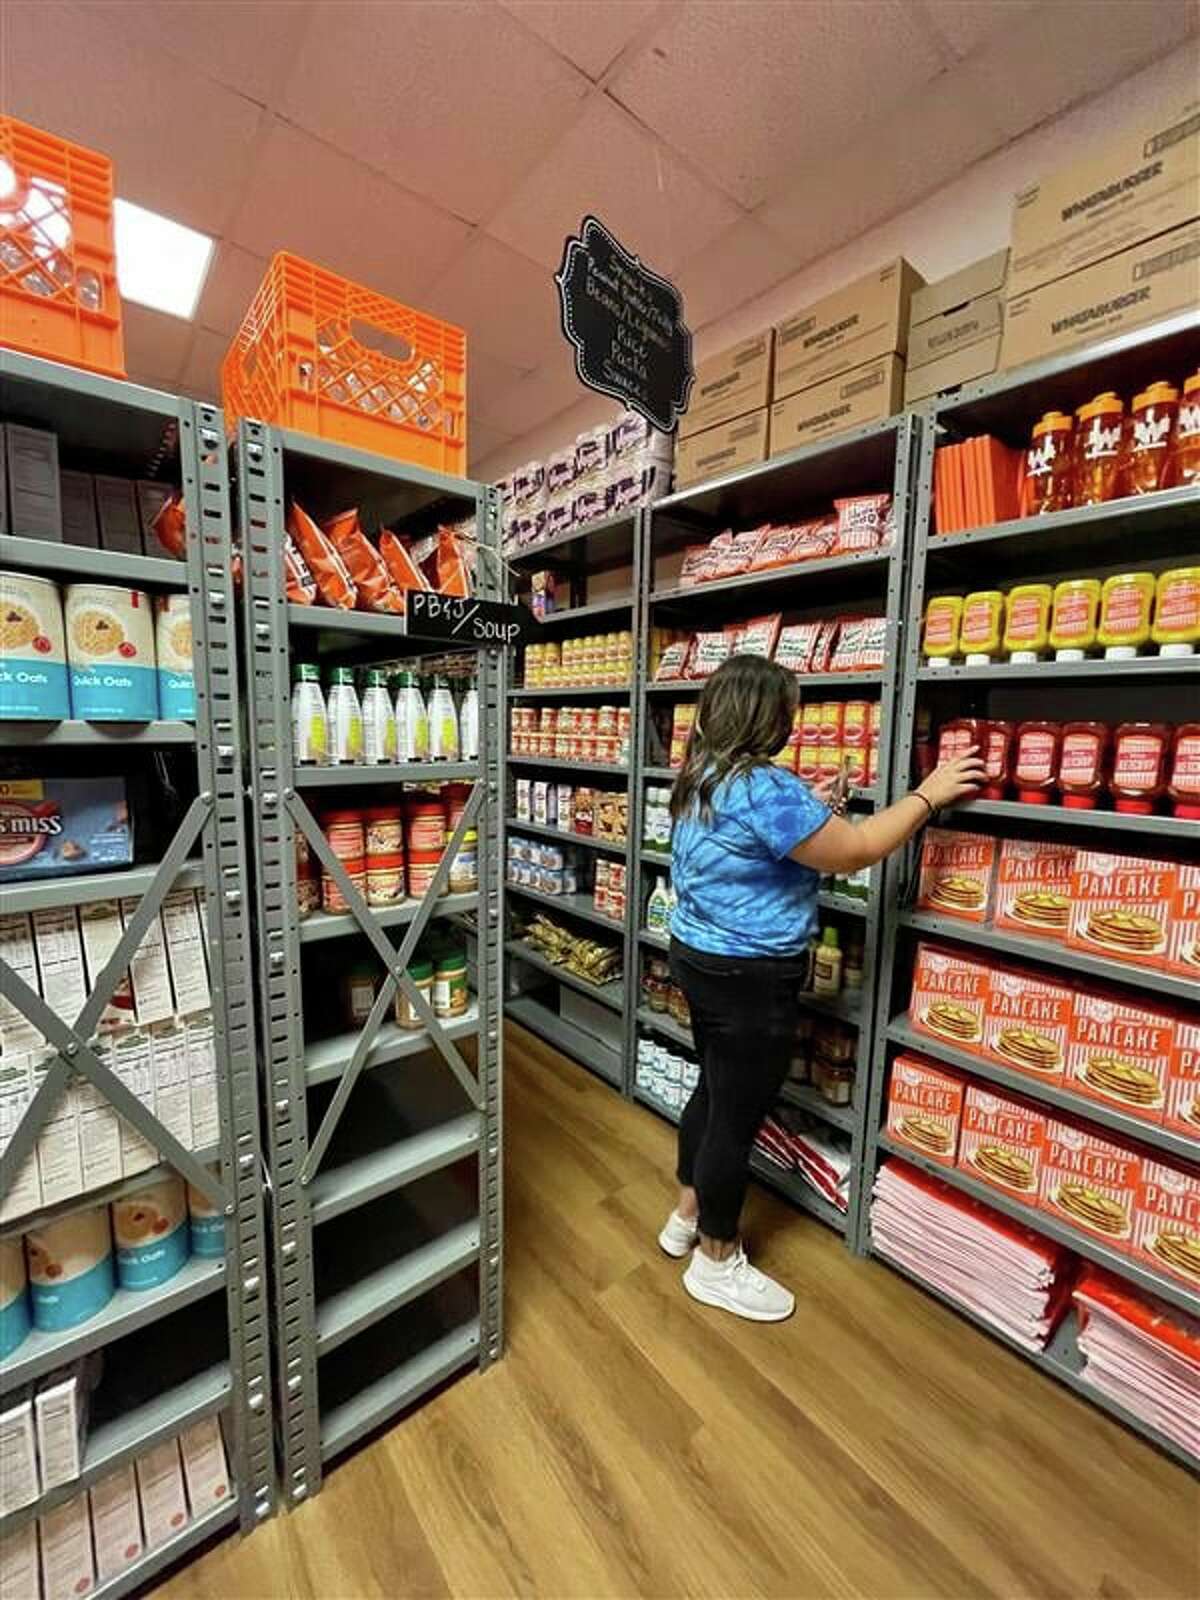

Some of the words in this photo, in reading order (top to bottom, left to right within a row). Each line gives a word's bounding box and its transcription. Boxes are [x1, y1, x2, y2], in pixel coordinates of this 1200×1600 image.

[473, 617, 521, 643] Soup
[16, 671, 48, 684] Oats
[103, 677, 132, 688] Oats
[927, 844, 985, 865] PANCAKE
[1006, 858, 1072, 881] PANCAK
[1078, 873, 1161, 897] PANCAKE
[920, 970, 981, 994] PANCAKE
[991, 995, 1062, 1021] PANCAKE
[1077, 1018, 1160, 1050] PANCAKE
[894, 1081, 953, 1108] PANCAKE
[968, 1107, 1035, 1141] PANCAKE
[1050, 1144, 1128, 1183] PANCAKE
[1145, 1185, 1200, 1222] PANC
